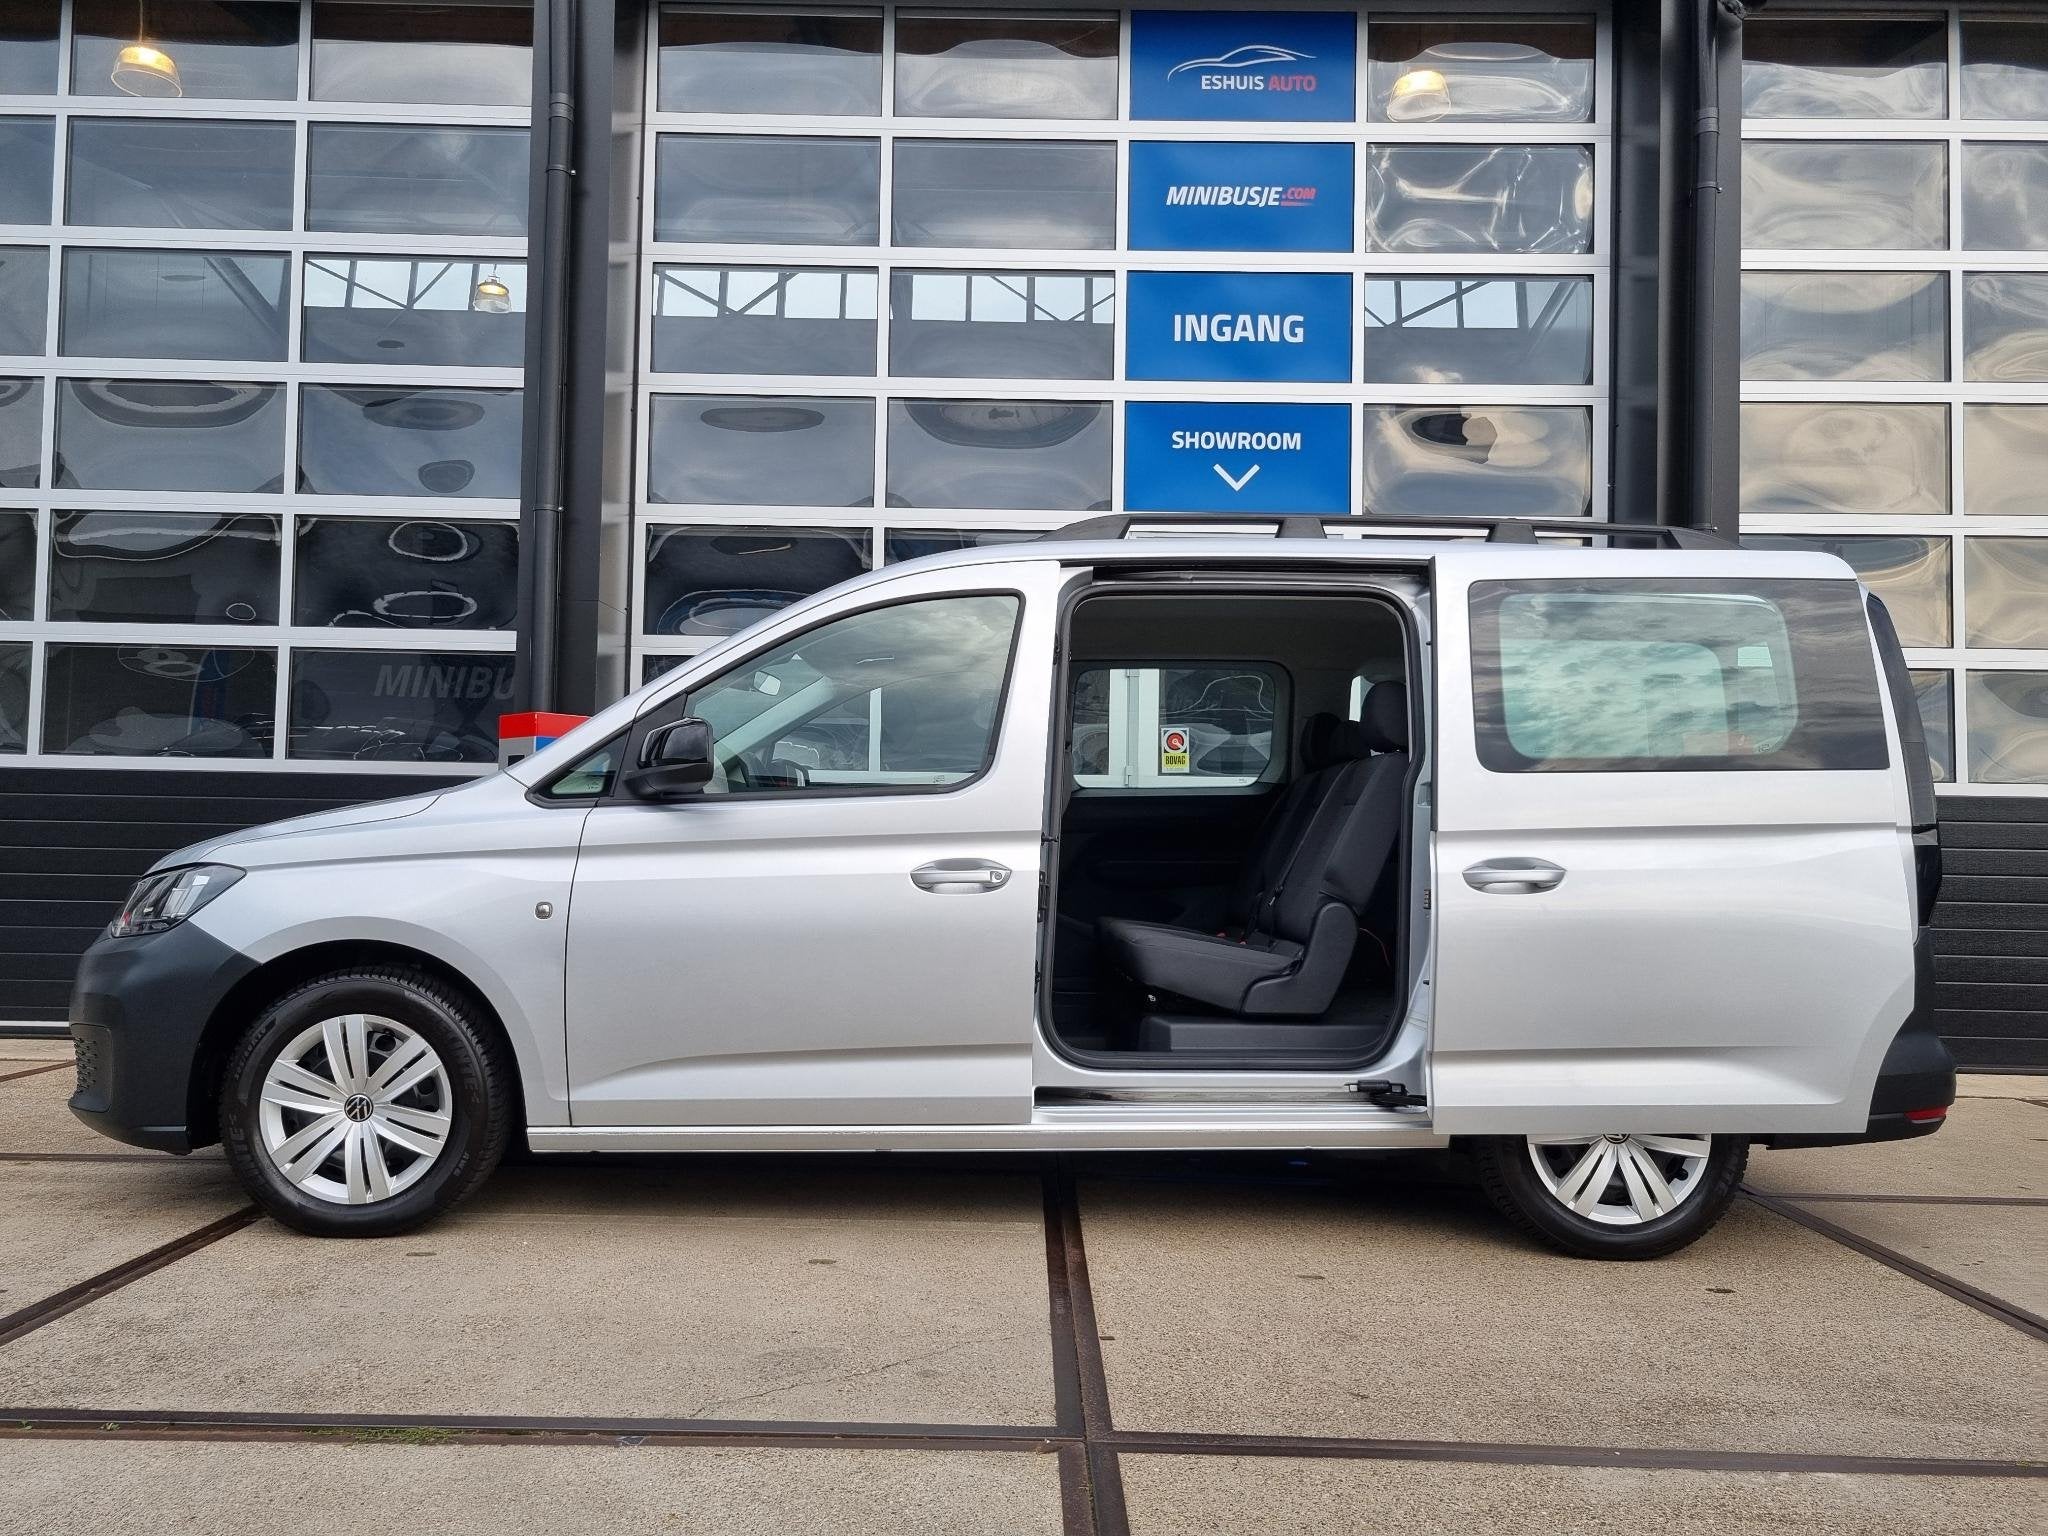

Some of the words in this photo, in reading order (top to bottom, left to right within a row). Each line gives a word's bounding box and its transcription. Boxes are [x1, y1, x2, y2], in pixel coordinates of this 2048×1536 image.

[1201, 75, 1264, 91] ESHUIS
[1268, 75, 1317, 92] AUTO
[1174, 314, 1304, 343] INGANG
[1172, 431, 1302, 451] SHOWROOM
[1165, 755, 1186, 765] BOVAG
